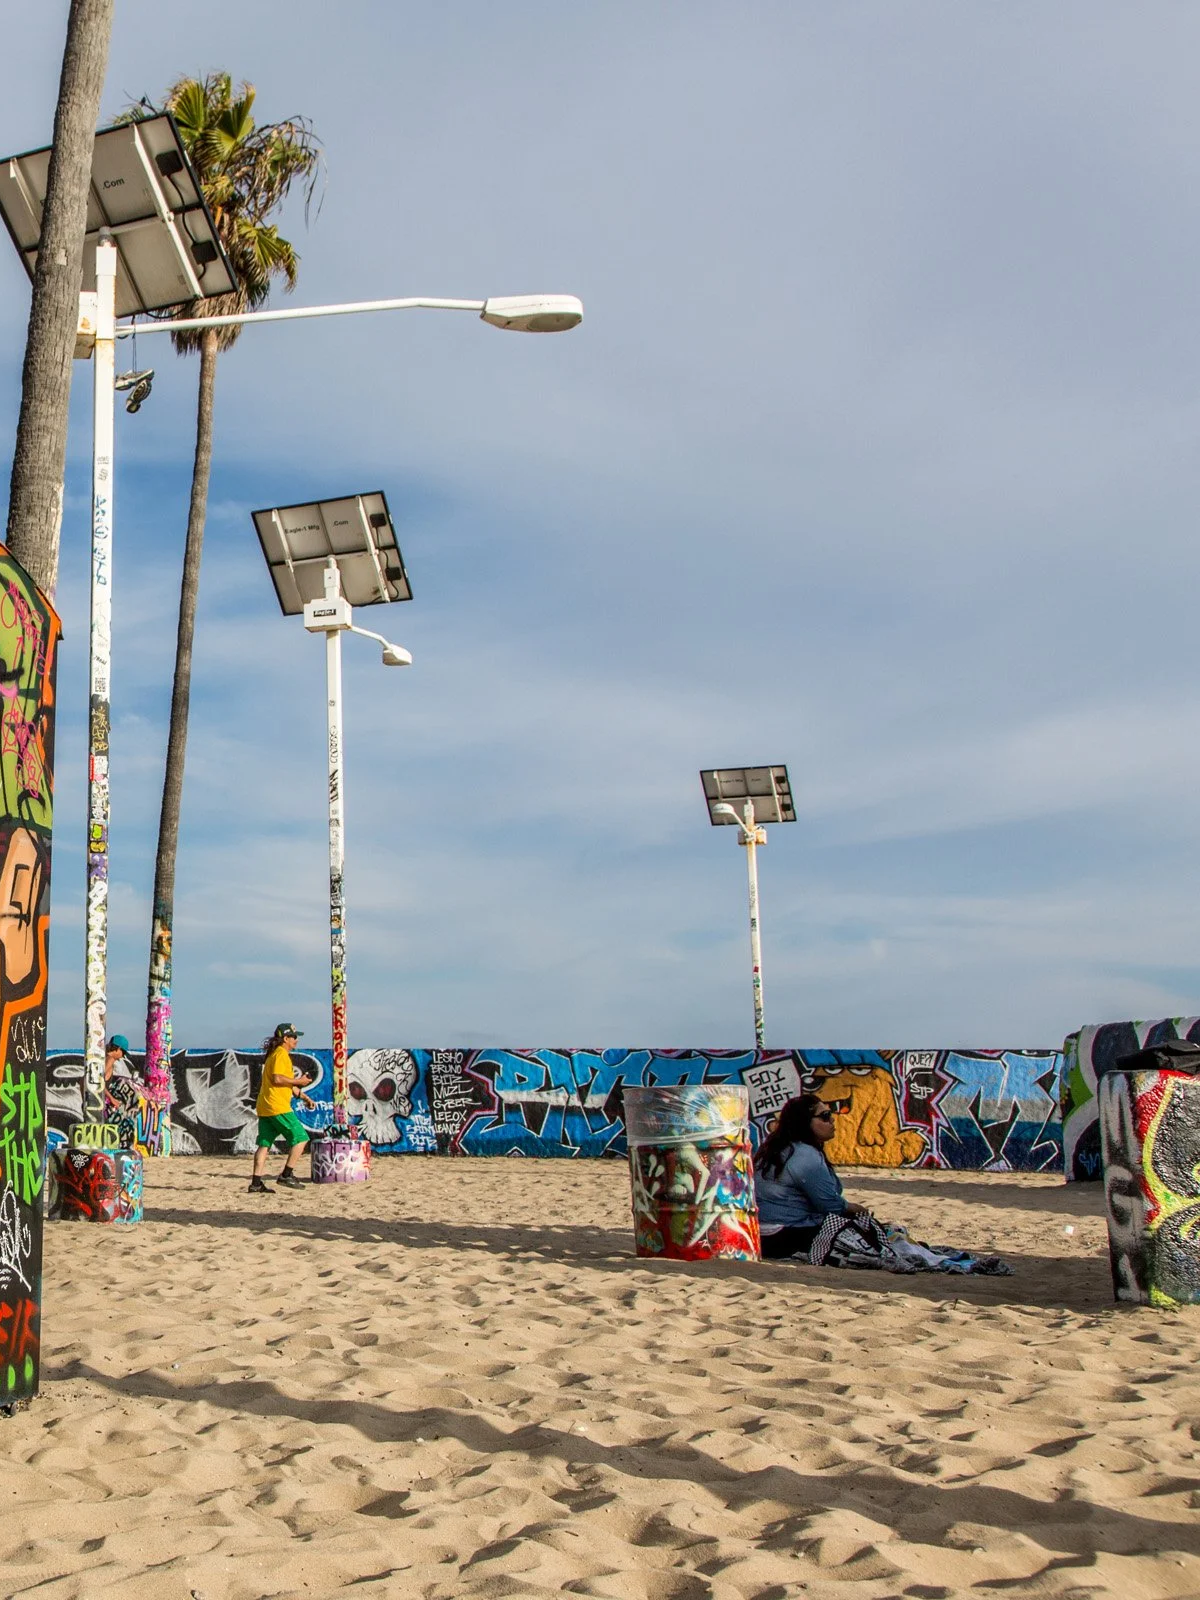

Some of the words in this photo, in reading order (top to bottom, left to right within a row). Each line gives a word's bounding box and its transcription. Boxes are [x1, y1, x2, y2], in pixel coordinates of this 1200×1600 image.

[433, 1051, 463, 1064] LESHO
[430, 1064, 462, 1074] BRUNO
[749, 1068, 785, 1088] SOY
[434, 1110, 467, 1122] LEEOX
